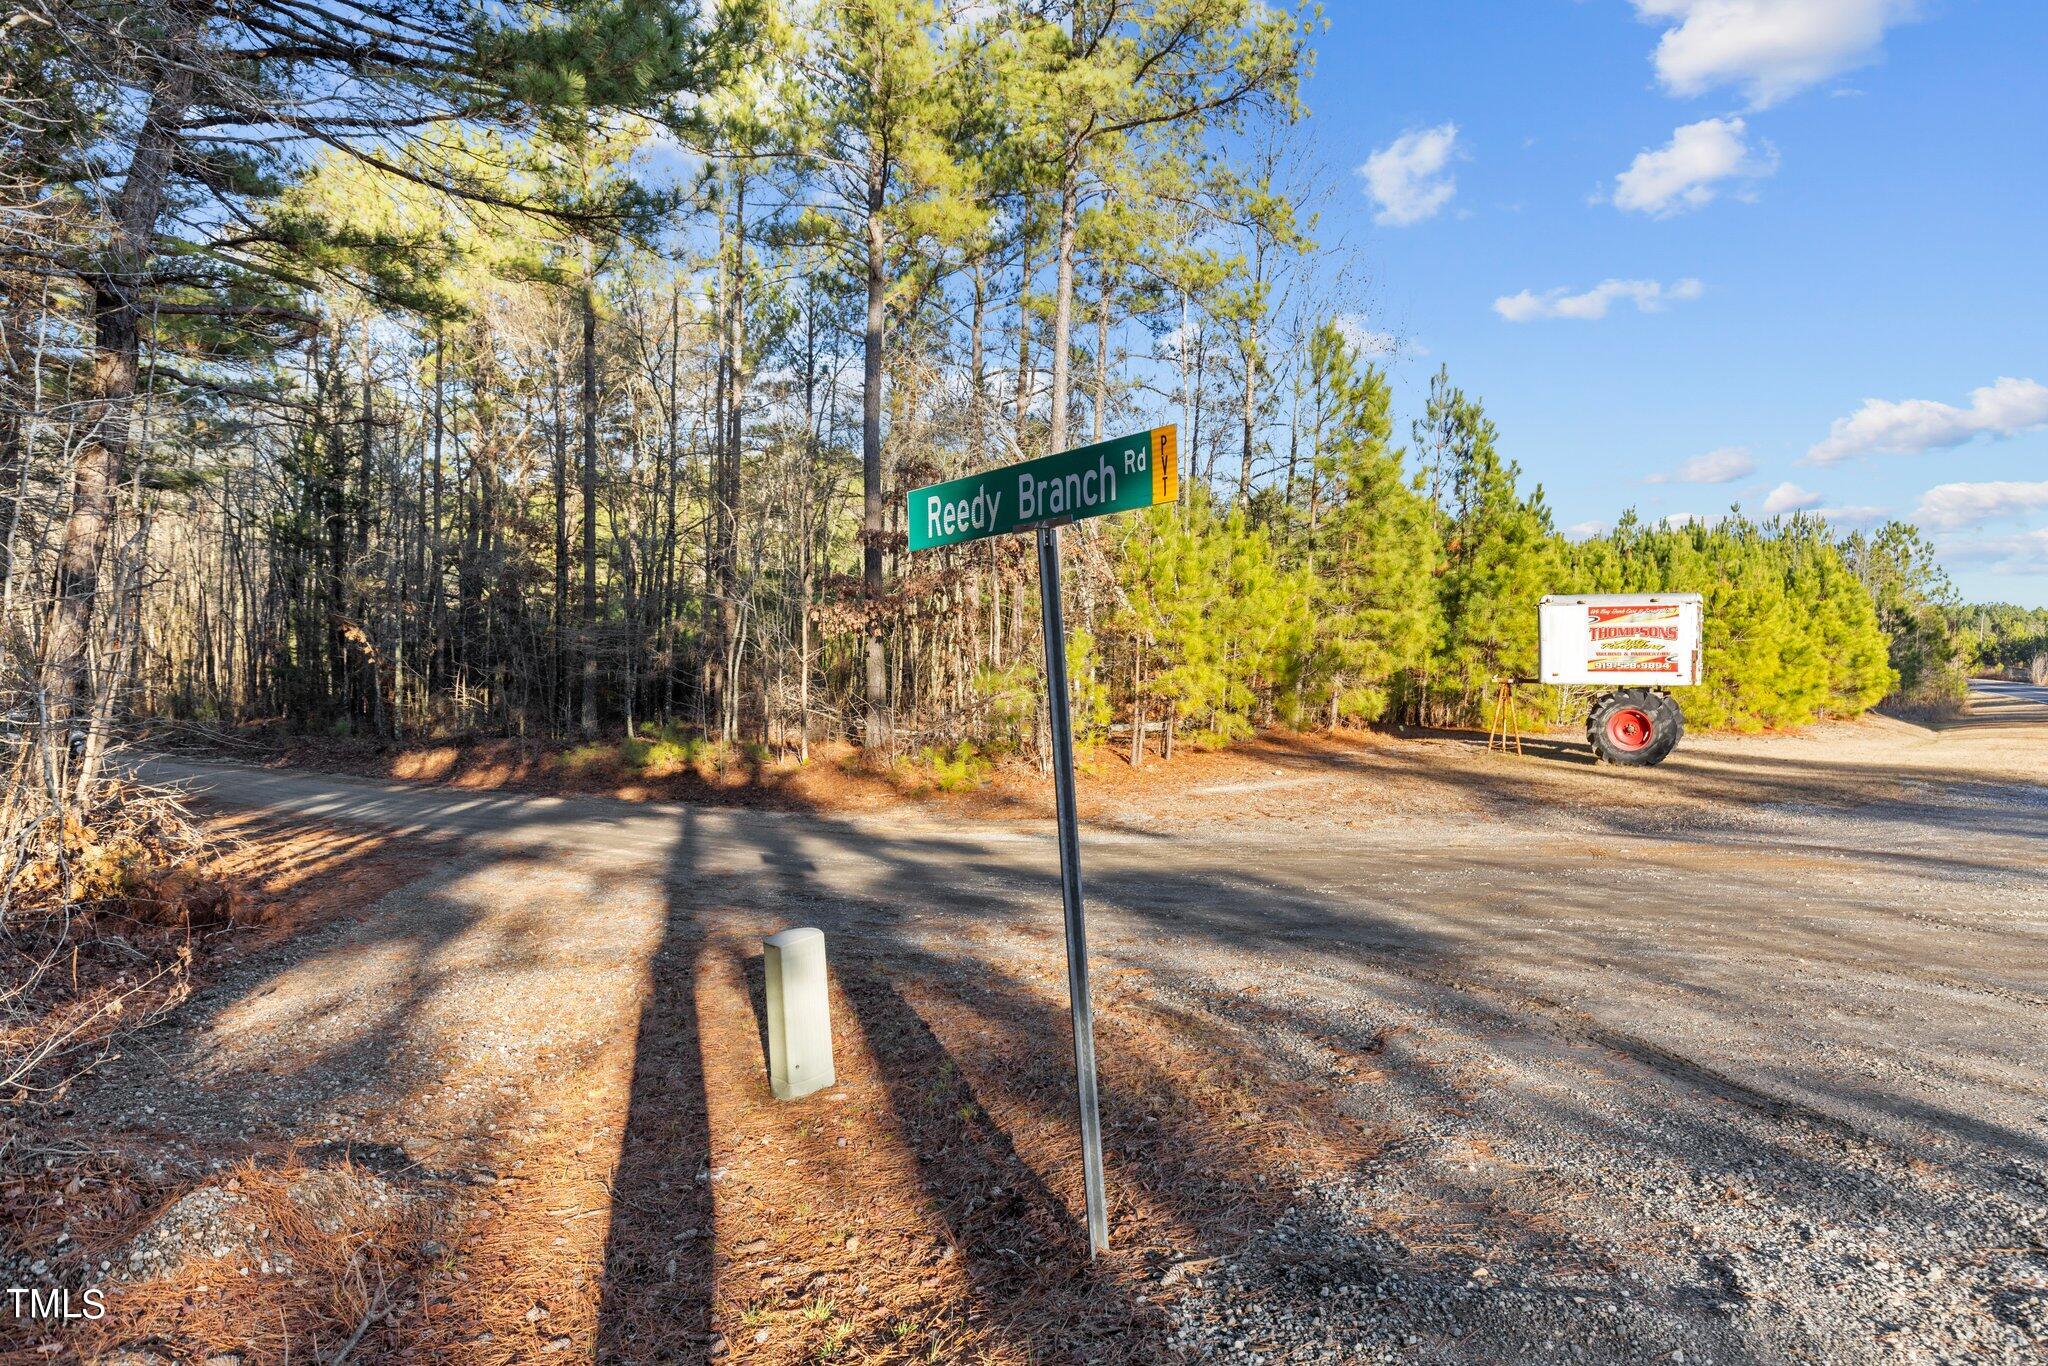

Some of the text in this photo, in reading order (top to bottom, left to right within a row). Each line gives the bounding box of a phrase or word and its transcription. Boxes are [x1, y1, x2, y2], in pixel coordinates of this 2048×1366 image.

[927, 446, 1147, 539] Reedy Branch Rd
[1159, 434, 1169, 498] PVT
[1589, 626, 1679, 641] THOMPSONS
